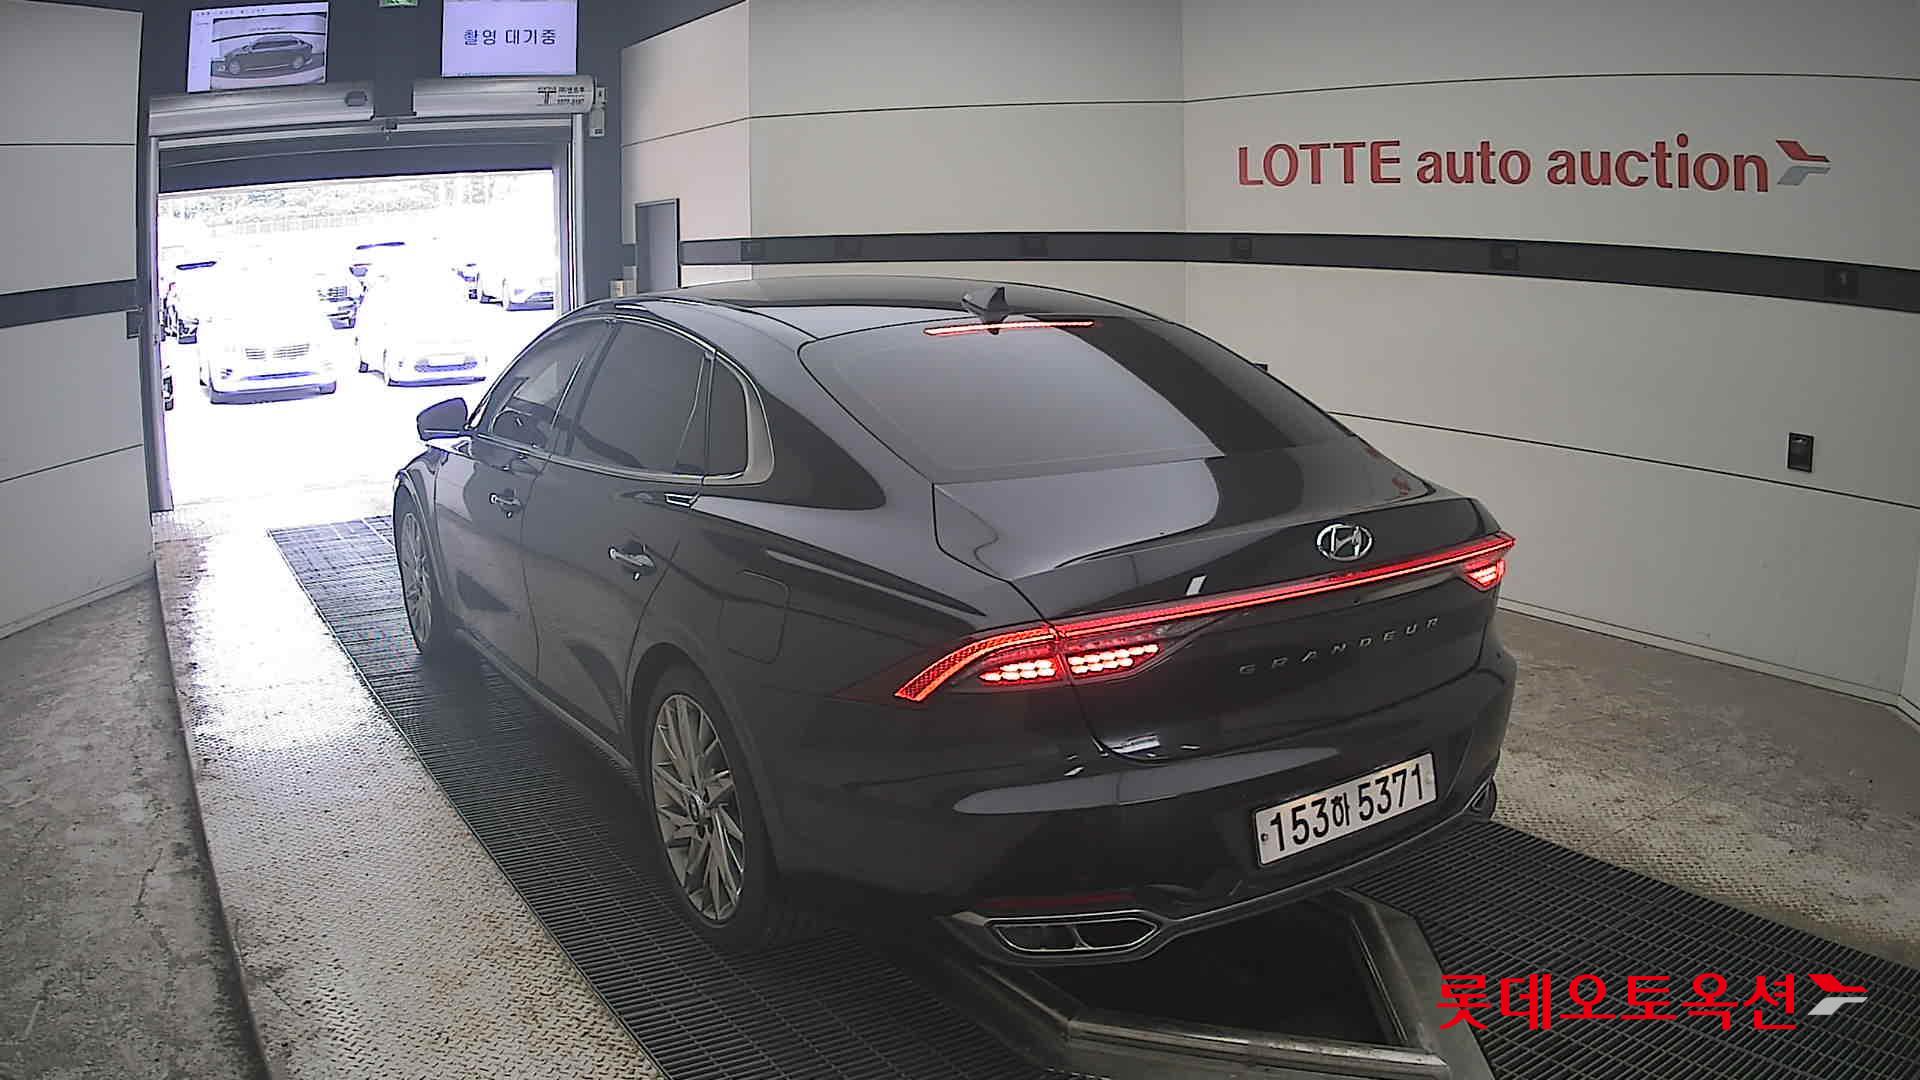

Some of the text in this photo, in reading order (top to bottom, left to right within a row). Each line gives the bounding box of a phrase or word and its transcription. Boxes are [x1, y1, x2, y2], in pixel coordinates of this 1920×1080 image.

[505, 29, 556, 45] 대기중
[1238, 134, 1769, 193] LOTTE auto auction
[1239, 617, 1440, 675] GRANDEUR
